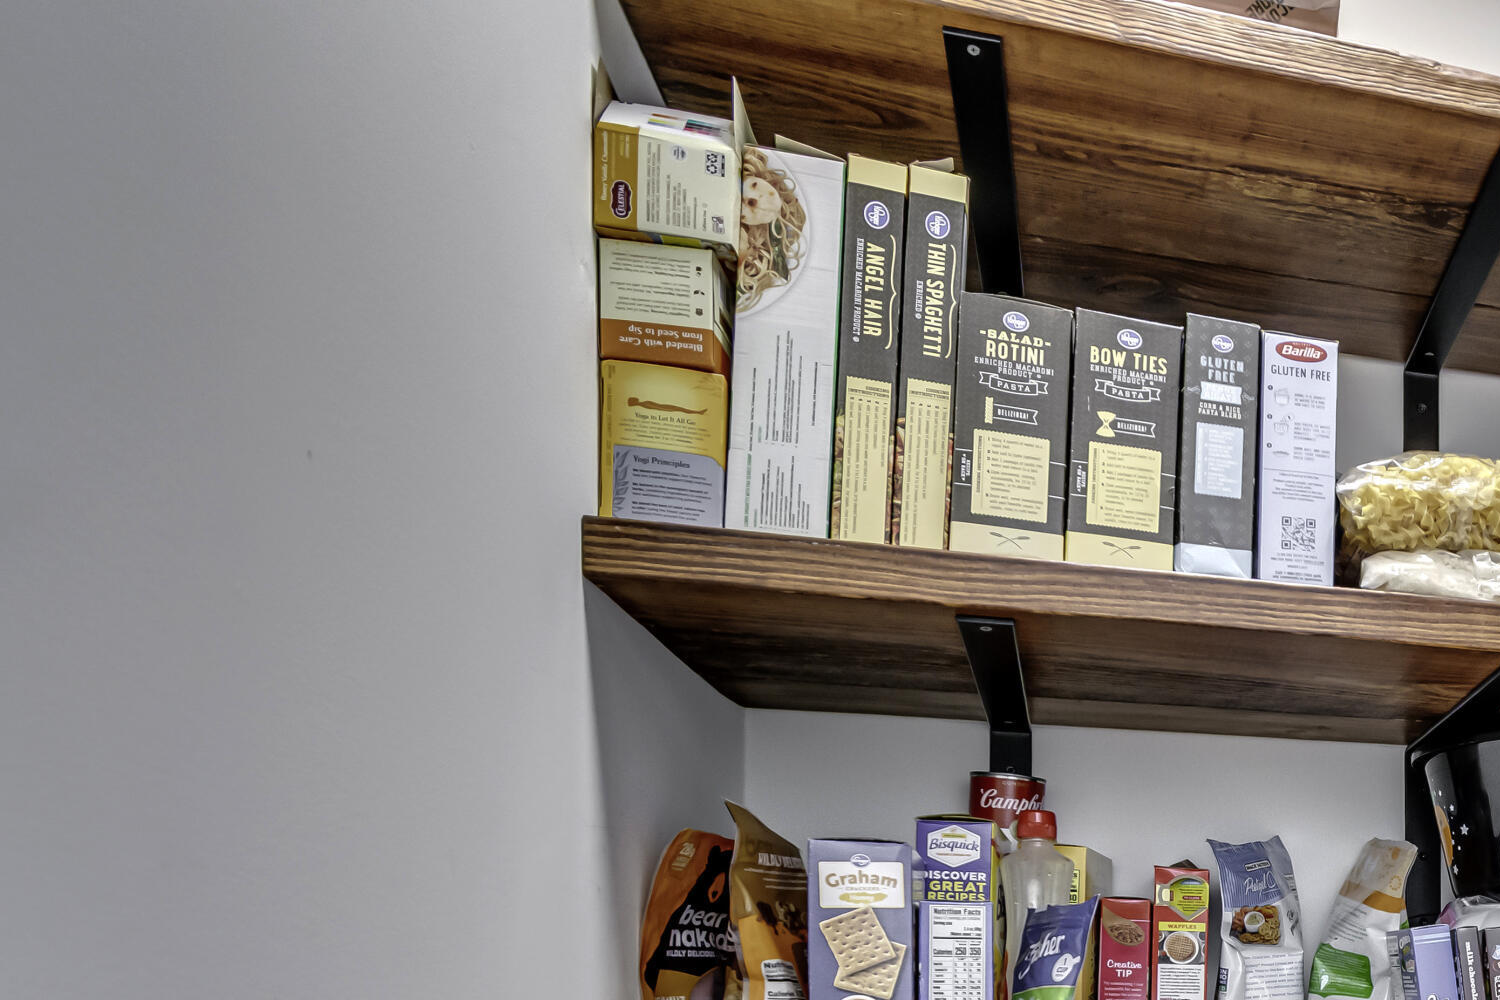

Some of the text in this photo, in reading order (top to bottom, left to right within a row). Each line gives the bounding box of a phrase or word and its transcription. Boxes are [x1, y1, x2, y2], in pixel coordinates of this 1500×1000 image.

[863, 243, 886, 337] ANGEL HAIR
[923, 243, 946, 358] THIN SPAGHETTI
[628, 325, 642, 334] Sip
[657, 329, 679, 338] Seed
[619, 335, 703, 352] Blended with Care
[986, 339, 1044, 366] ROTINI
[1282, 344, 1321, 359] Barilla
[974, 356, 1054, 376] ENRICHED MACARONI
[1090, 345, 1168, 375] BOW TIES
[1200, 355, 1244, 373] GLUTEN
[998, 367, 1032, 378] PRODUCT
[1090, 364, 1166, 383] ENRICHED MACARONI
[1208, 368, 1236, 384] FREE
[1271, 364, 1331, 381] GLUTEN FREE
[997, 381, 1030, 393] PASTA
[1113, 375, 1146, 386] PRODUCT
[1112, 388, 1144, 399] PASTA
[1198, 408, 1242, 420] PASTA BLEND
[1200, 402, 1241, 414] CORN RICE
[633, 455, 690, 468] Yogi Principles
[929, 838, 979, 852] Bisquick
[825, 870, 898, 889] Graham
[923, 870, 987, 882] DISCOVER
[929, 881, 986, 893] GREAT
[927, 892, 985, 902] RECIPES
[679, 904, 729, 927] bear
[955, 946, 982, 956] 250 350
[1465, 941, 1473, 964] milk
[1106, 959, 1142, 970] Creative
[1115, 969, 1133, 978] TIP
